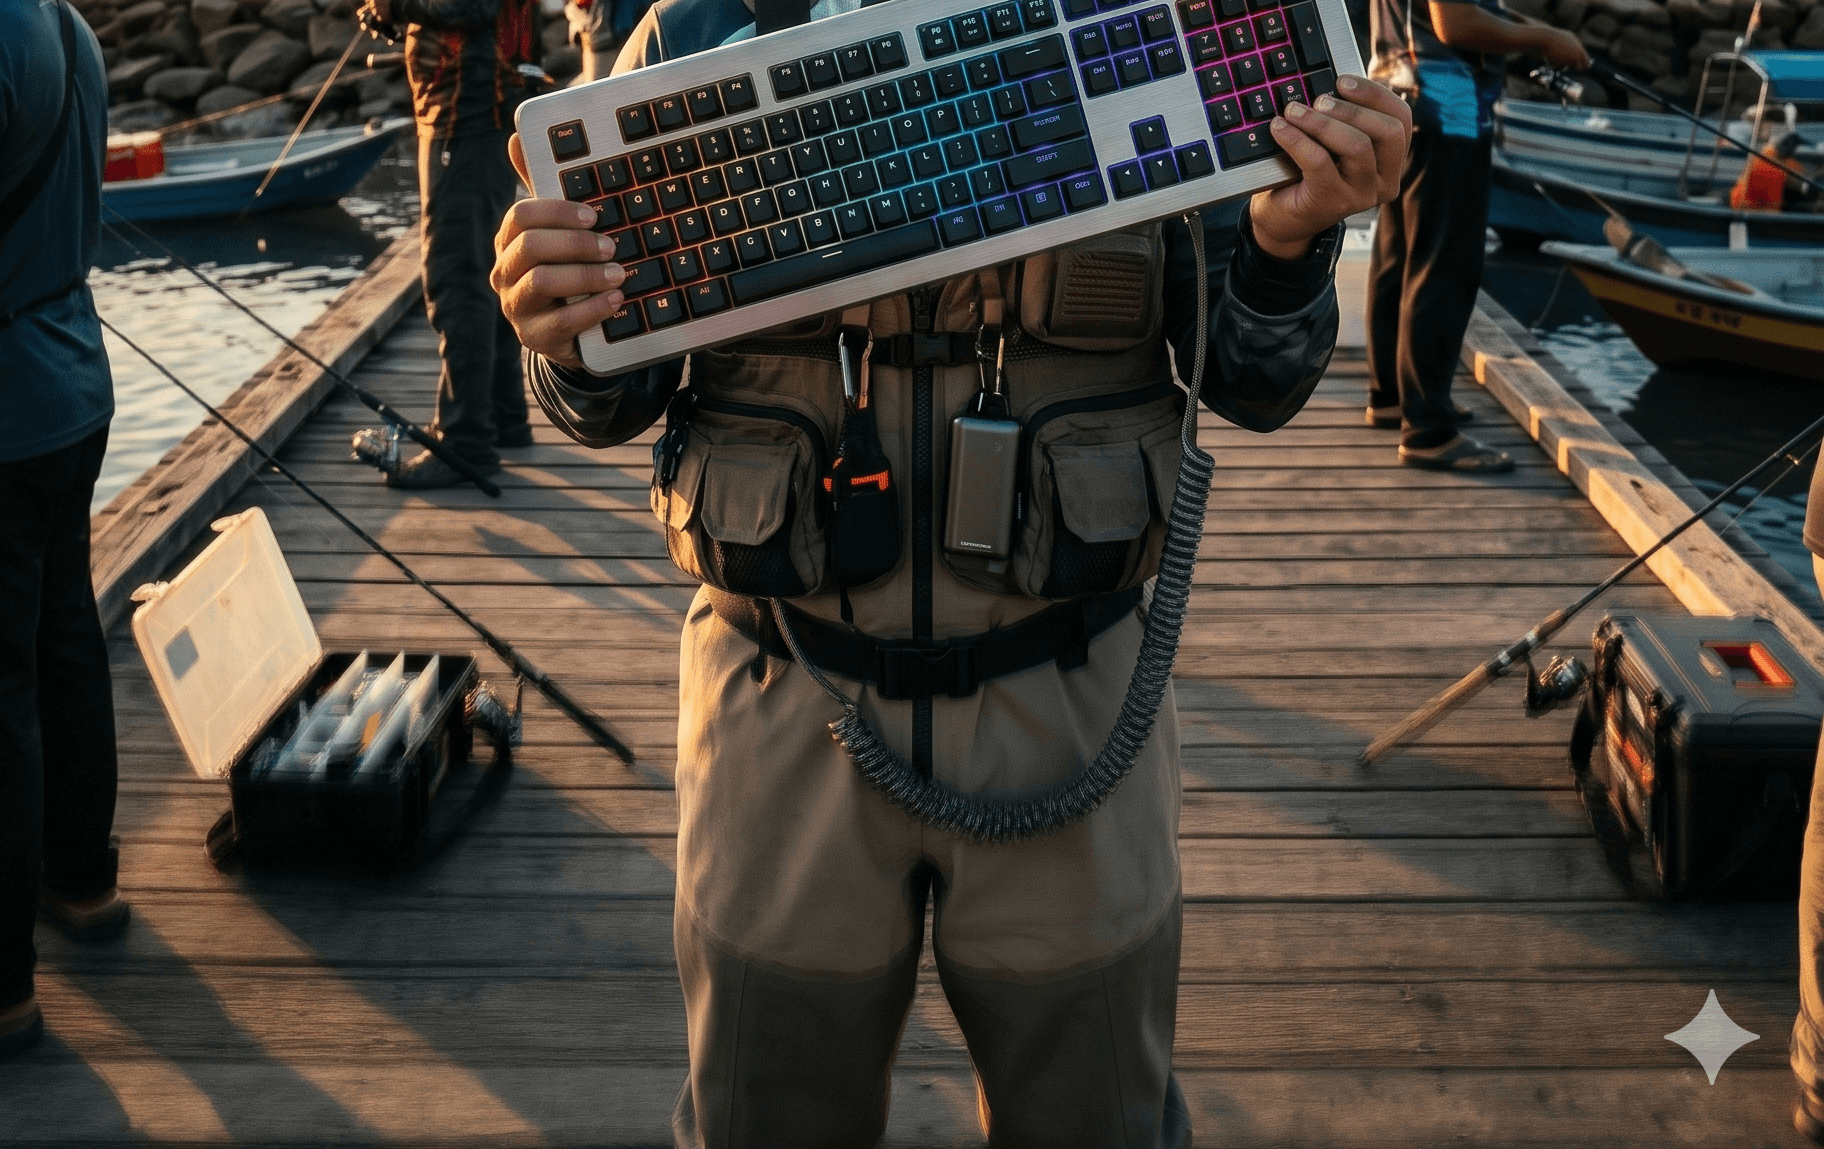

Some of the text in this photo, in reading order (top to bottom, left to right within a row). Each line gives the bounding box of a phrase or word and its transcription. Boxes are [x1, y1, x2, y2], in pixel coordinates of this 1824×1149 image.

[937, 110, 944, 118] P
[837, 138, 845, 146] U
[803, 147, 810, 155] Y
[922, 152, 930, 160] L
[769, 157, 776, 165] T
[889, 161, 897, 170] K
[702, 175, 710, 184] E
[857, 171, 863, 179] J
[822, 179, 830, 188] H
[667, 184, 676, 193] W
[754, 198, 761, 206] F
[882, 199, 891, 208] M
[720, 208, 728, 216] D
[848, 208, 856, 217] N
[686, 217, 694, 225] S
[814, 218, 822, 227] B
[653, 226, 660, 235] A
[780, 228, 787, 237] V
[713, 246, 720, 255] X
